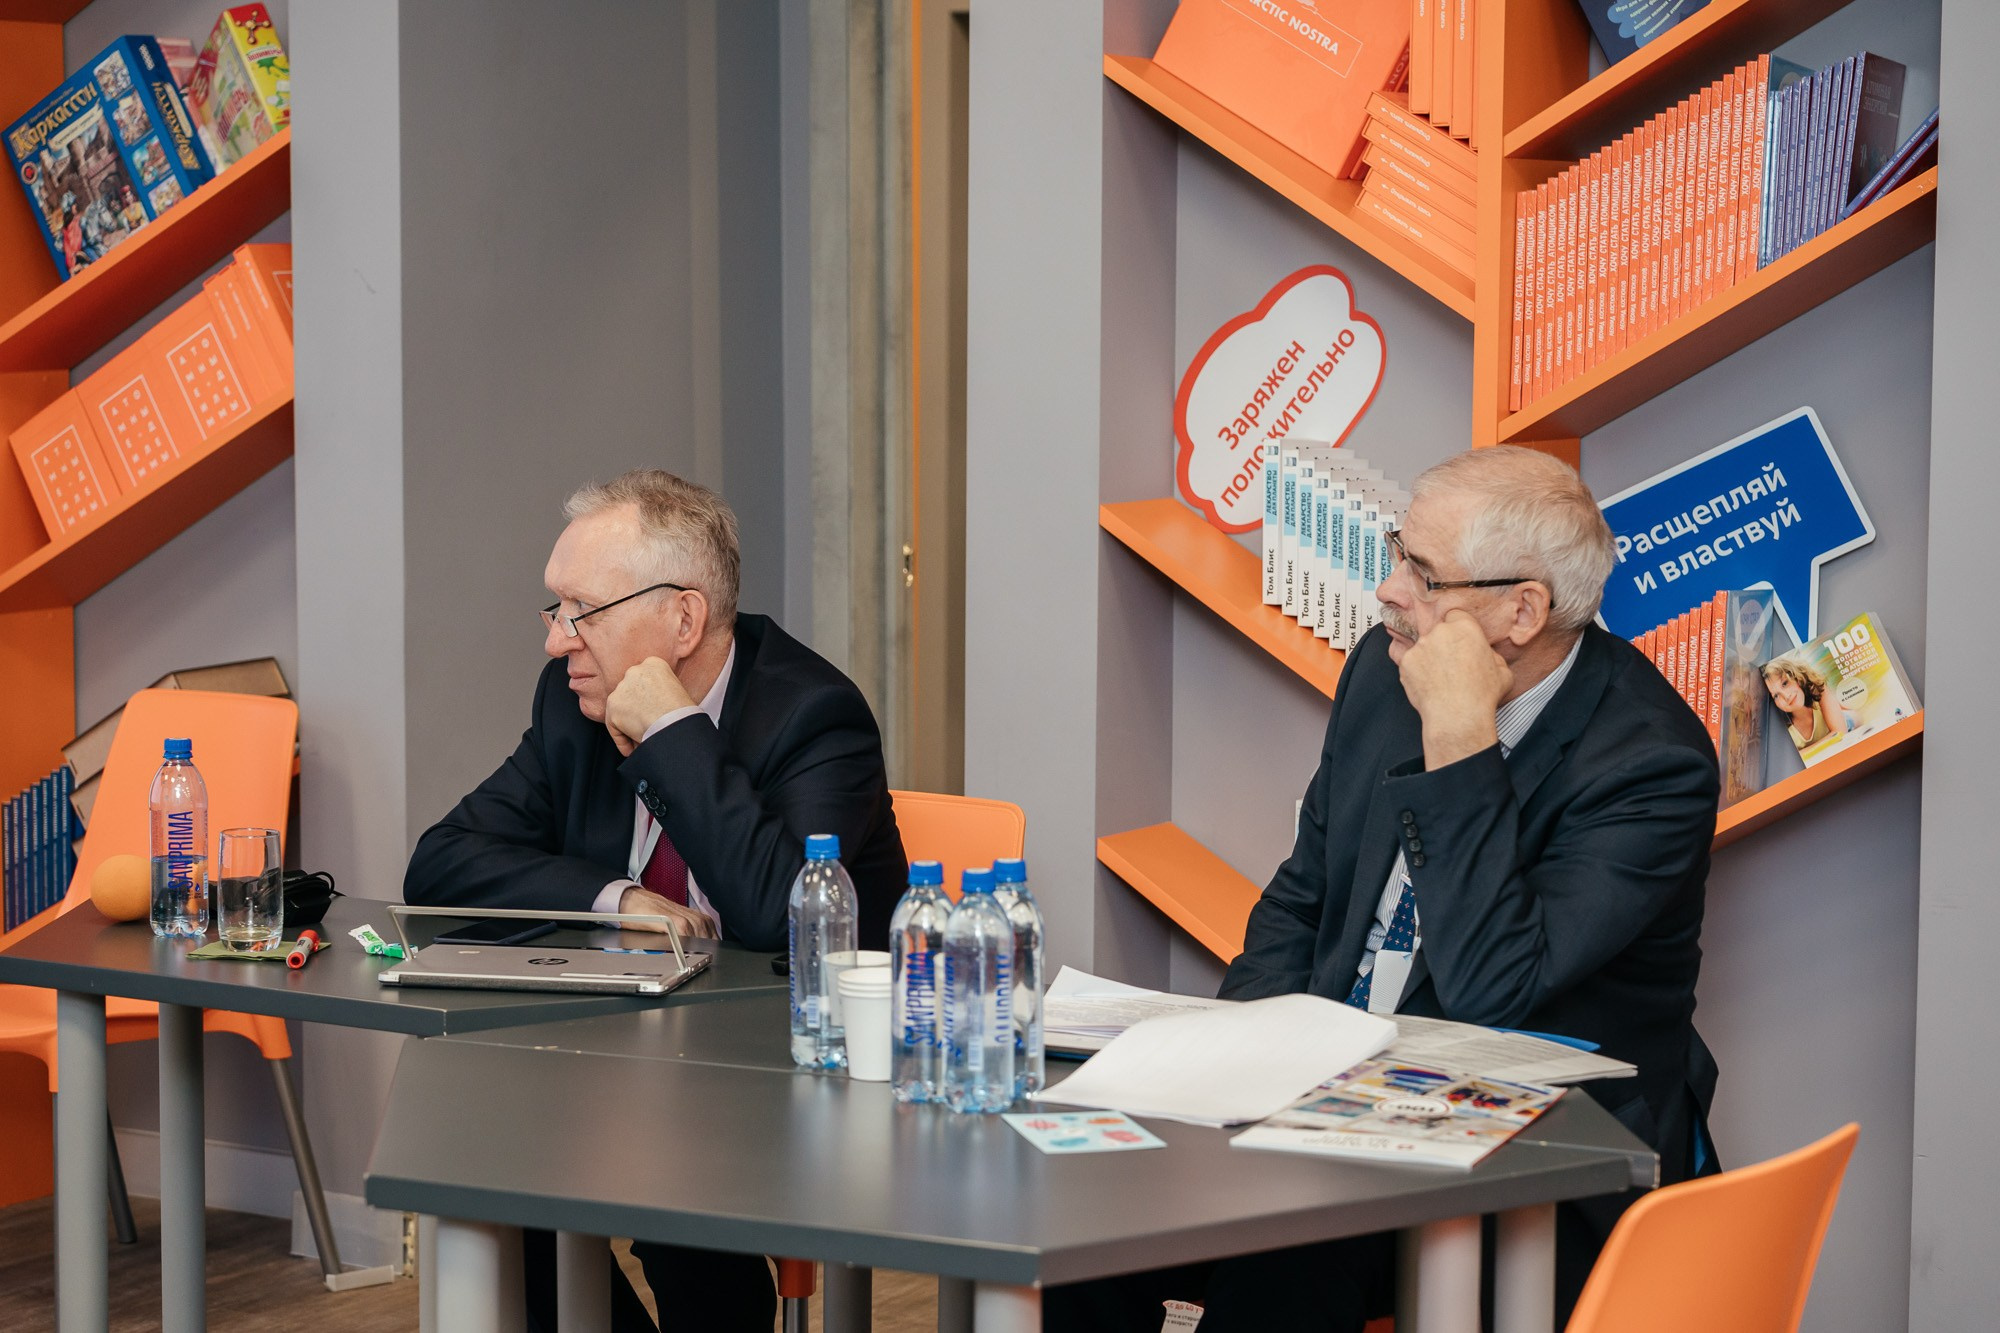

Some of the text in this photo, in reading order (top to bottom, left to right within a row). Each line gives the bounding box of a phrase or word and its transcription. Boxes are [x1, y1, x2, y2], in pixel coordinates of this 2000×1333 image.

[1249, 0, 1338, 55] RCTIC NOSTRA
[1664, 134, 1674, 240] ХОЧУ СТАТЬ АТОМЩИКОМ
[1674, 128, 1686, 233] ХОЧУ СТАТЬ АТОМЩИКОМ
[1686, 122, 1697, 228] ХОЧУ СТАТЬ АТОМЩИКОМ
[1696, 115, 1708, 221] ХОЧУ СТАТЬ АТОМЩИКОМ
[1719, 101, 1731, 208] ХОЧУ СТАТЬ АТОМЩИКОМ
[1730, 94, 1743, 200] ХОЧУ СТАТЬ АТОМЩИКОМ
[1742, 88, 1754, 195] ХОЧУ СТАТЬ АТОМЩИКОМ
[1548, 204, 1556, 257] АТОМЩИКОМ
[1558, 199, 1567, 251] АТОМЩИКОМ
[1567, 193, 1576, 297] ХОЧУ СТАТЬ АТОМЩИКОМ
[1578, 185, 1587, 290] ХОЧУ СТАТЬ АТОМЩИКОМ
[1589, 180, 1599, 284] ХОЧУ СТАТЬ АТОМЩИКОМ
[1610, 168, 1620, 272] ХОЧУ СТАТЬ АТОМЩИКОМ
[1621, 161, 1631, 266] ХОЧУ СТАТЬ АТОМЩИКОМ
[1631, 155, 1642, 260] ХОЧУ СТАТЬ АТОМЩИКОМ
[1515, 218, 1525, 321] ХОЧУ СТАТЬ АТОМЩИКОМ
[1526, 217, 1535, 320] ХОЧУ СТАТЬ АТОМЩИКОМ
[1547, 287, 1555, 308] ХОЧУ
[1558, 254, 1566, 279] СТАТЬ
[1218, 340, 1306, 450] Заряжен
[1617, 462, 1788, 563] Расщепляй
[1634, 498, 1802, 595] и властвуй
[1317, 582, 1325, 629] Том Блис
[1823, 623, 1871, 659] 100
[1678, 641, 1687, 695] АТОМЩИКОМ
[1688, 635, 1698, 690] АТОМЩИКОМ
[1698, 629, 1710, 710] СТАТЬ АТОМЩИКОМ
[1711, 618, 1724, 724] ХОЧУ СТАТЬ АТОМЩИКОМ
[168, 811, 193, 889] SANPRIMA
[905, 950, 935, 1047] SANPRIMA
